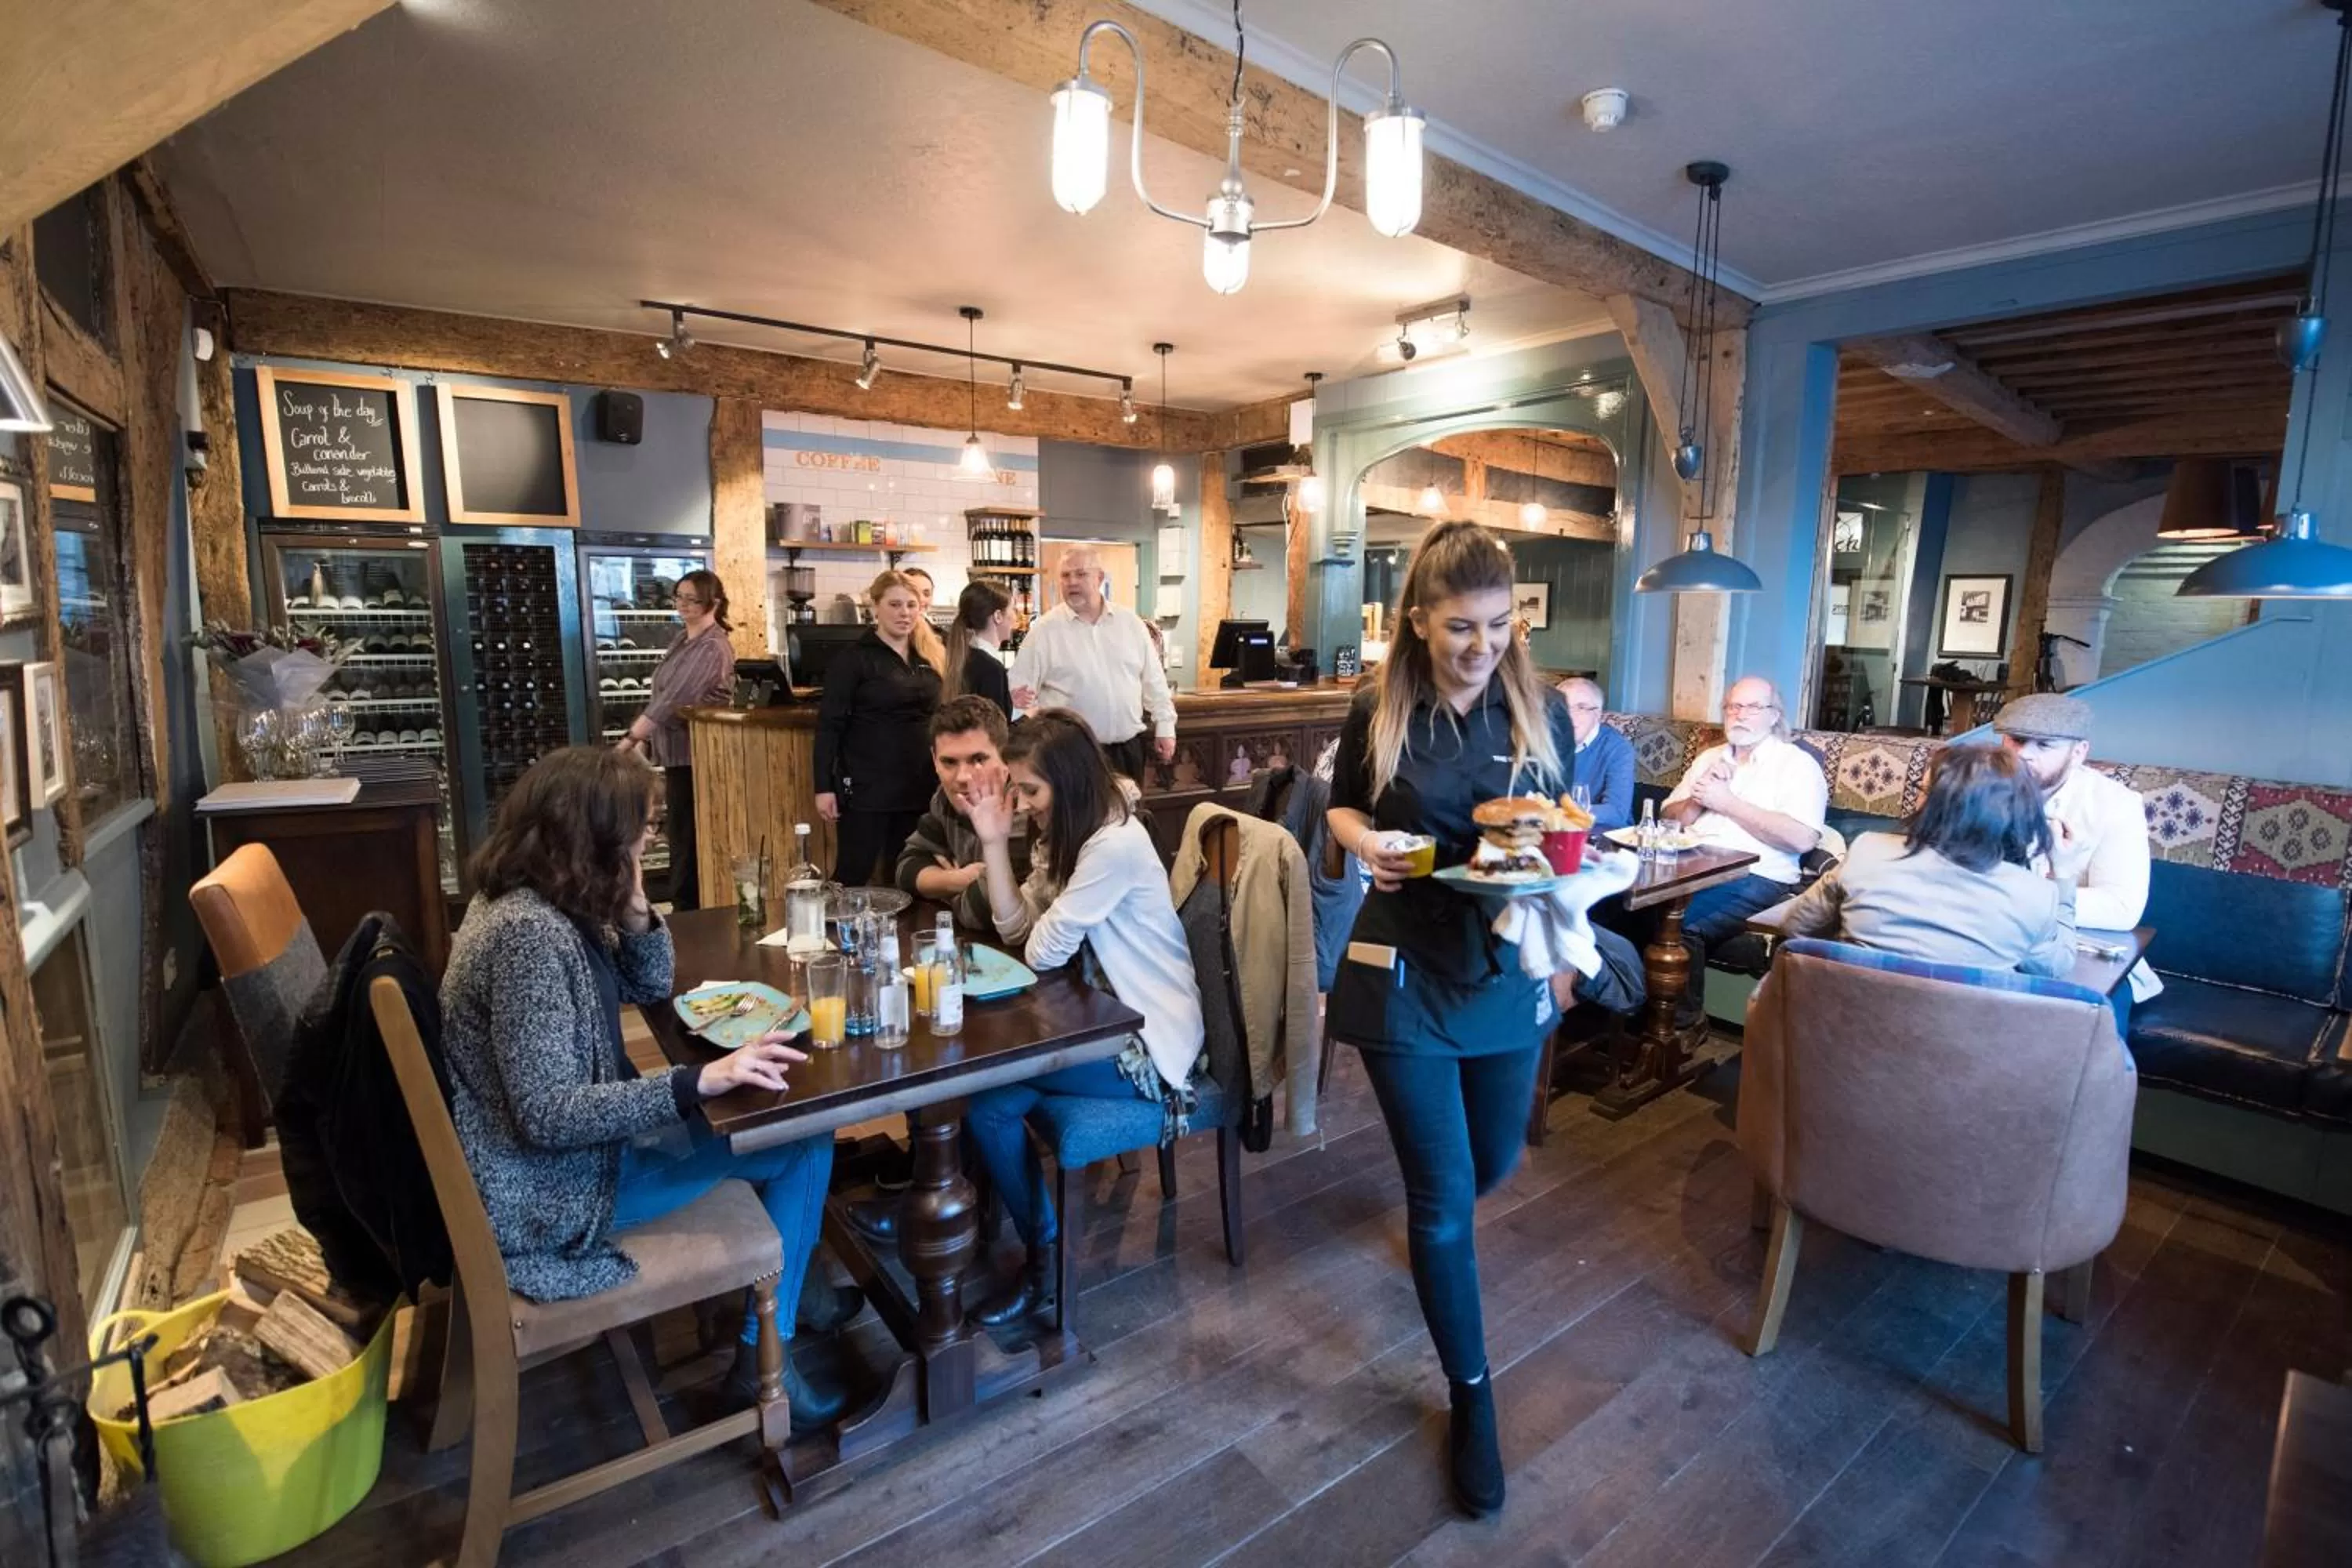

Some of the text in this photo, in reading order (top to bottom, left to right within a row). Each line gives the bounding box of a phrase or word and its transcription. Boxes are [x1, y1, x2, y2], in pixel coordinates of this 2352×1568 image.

[283, 390, 376, 424] Soup of the day
[291, 426, 353, 448] Carrot &
[339, 477, 351, 492] &
